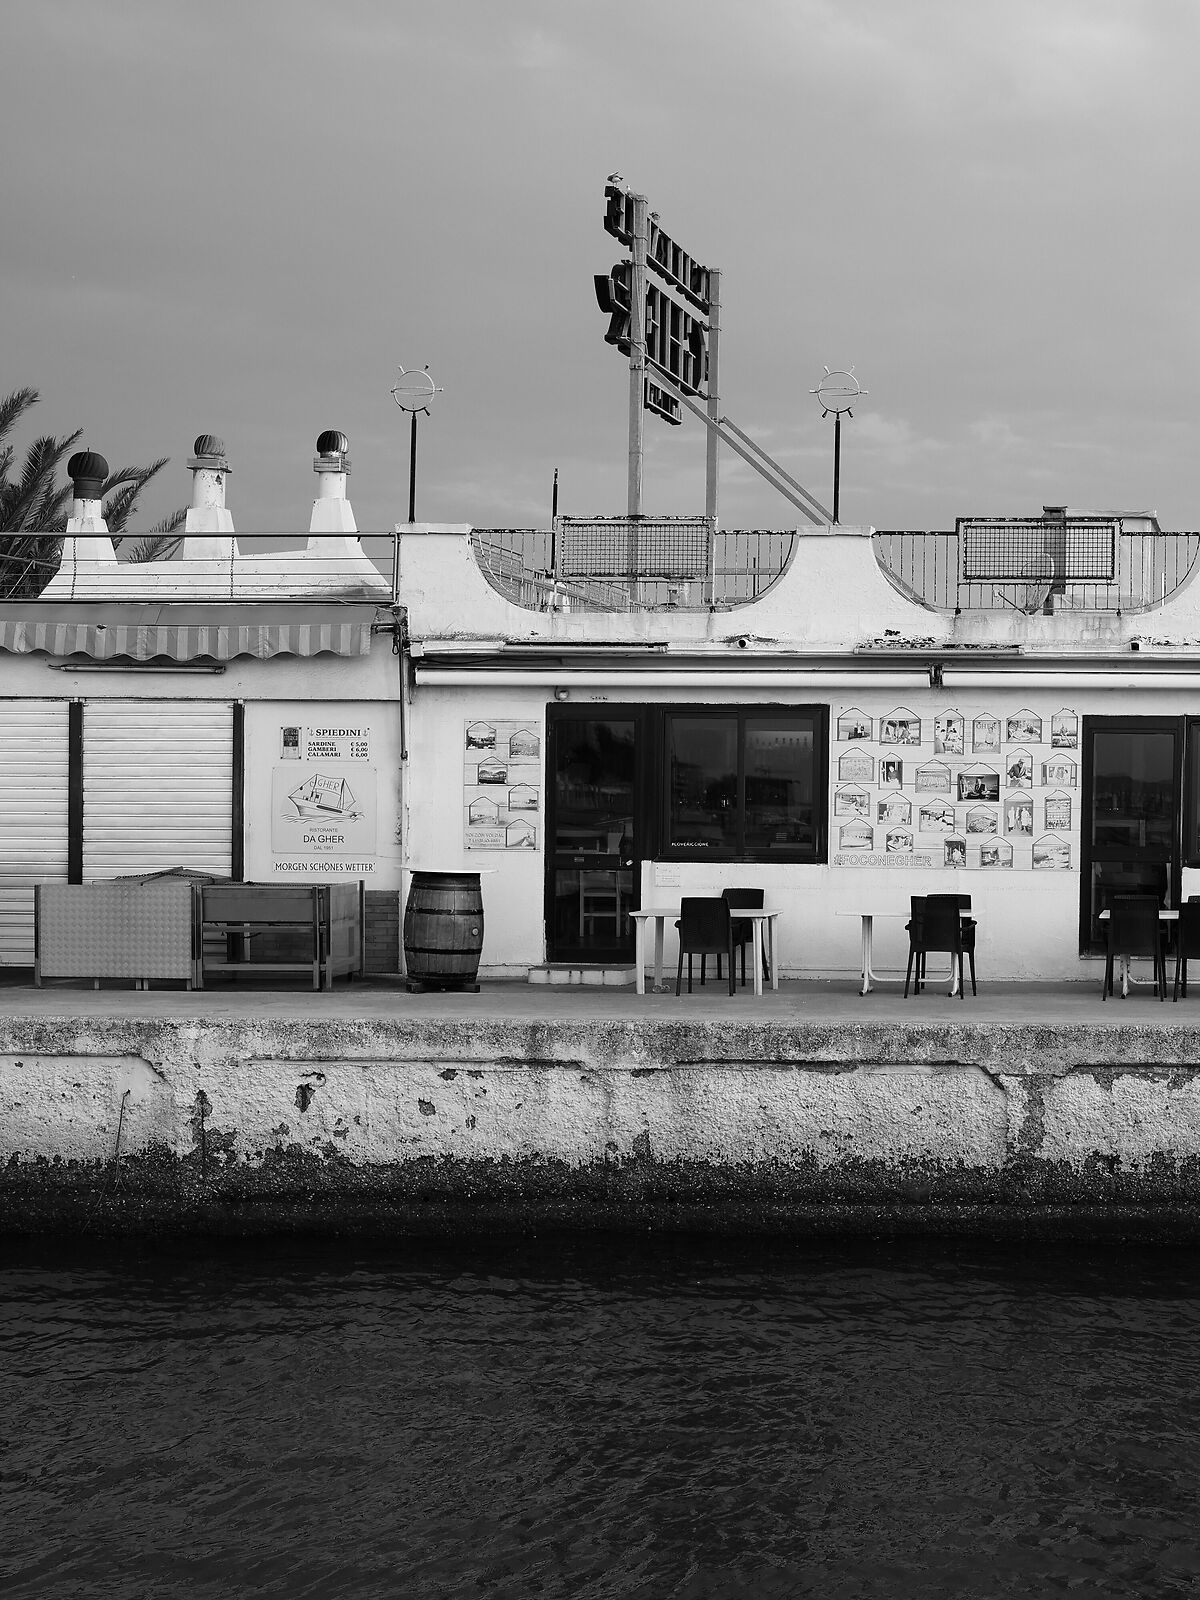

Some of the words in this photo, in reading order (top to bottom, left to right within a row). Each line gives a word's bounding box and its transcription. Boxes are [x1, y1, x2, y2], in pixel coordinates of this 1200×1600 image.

[315, 728, 361, 737] SPIEDINI
[317, 778, 340, 791] GHER
[303, 834, 316, 843] DA
[317, 834, 345, 843] GHER
[275, 862, 308, 871] MORGEN
[345, 863, 374, 872] WETTER
